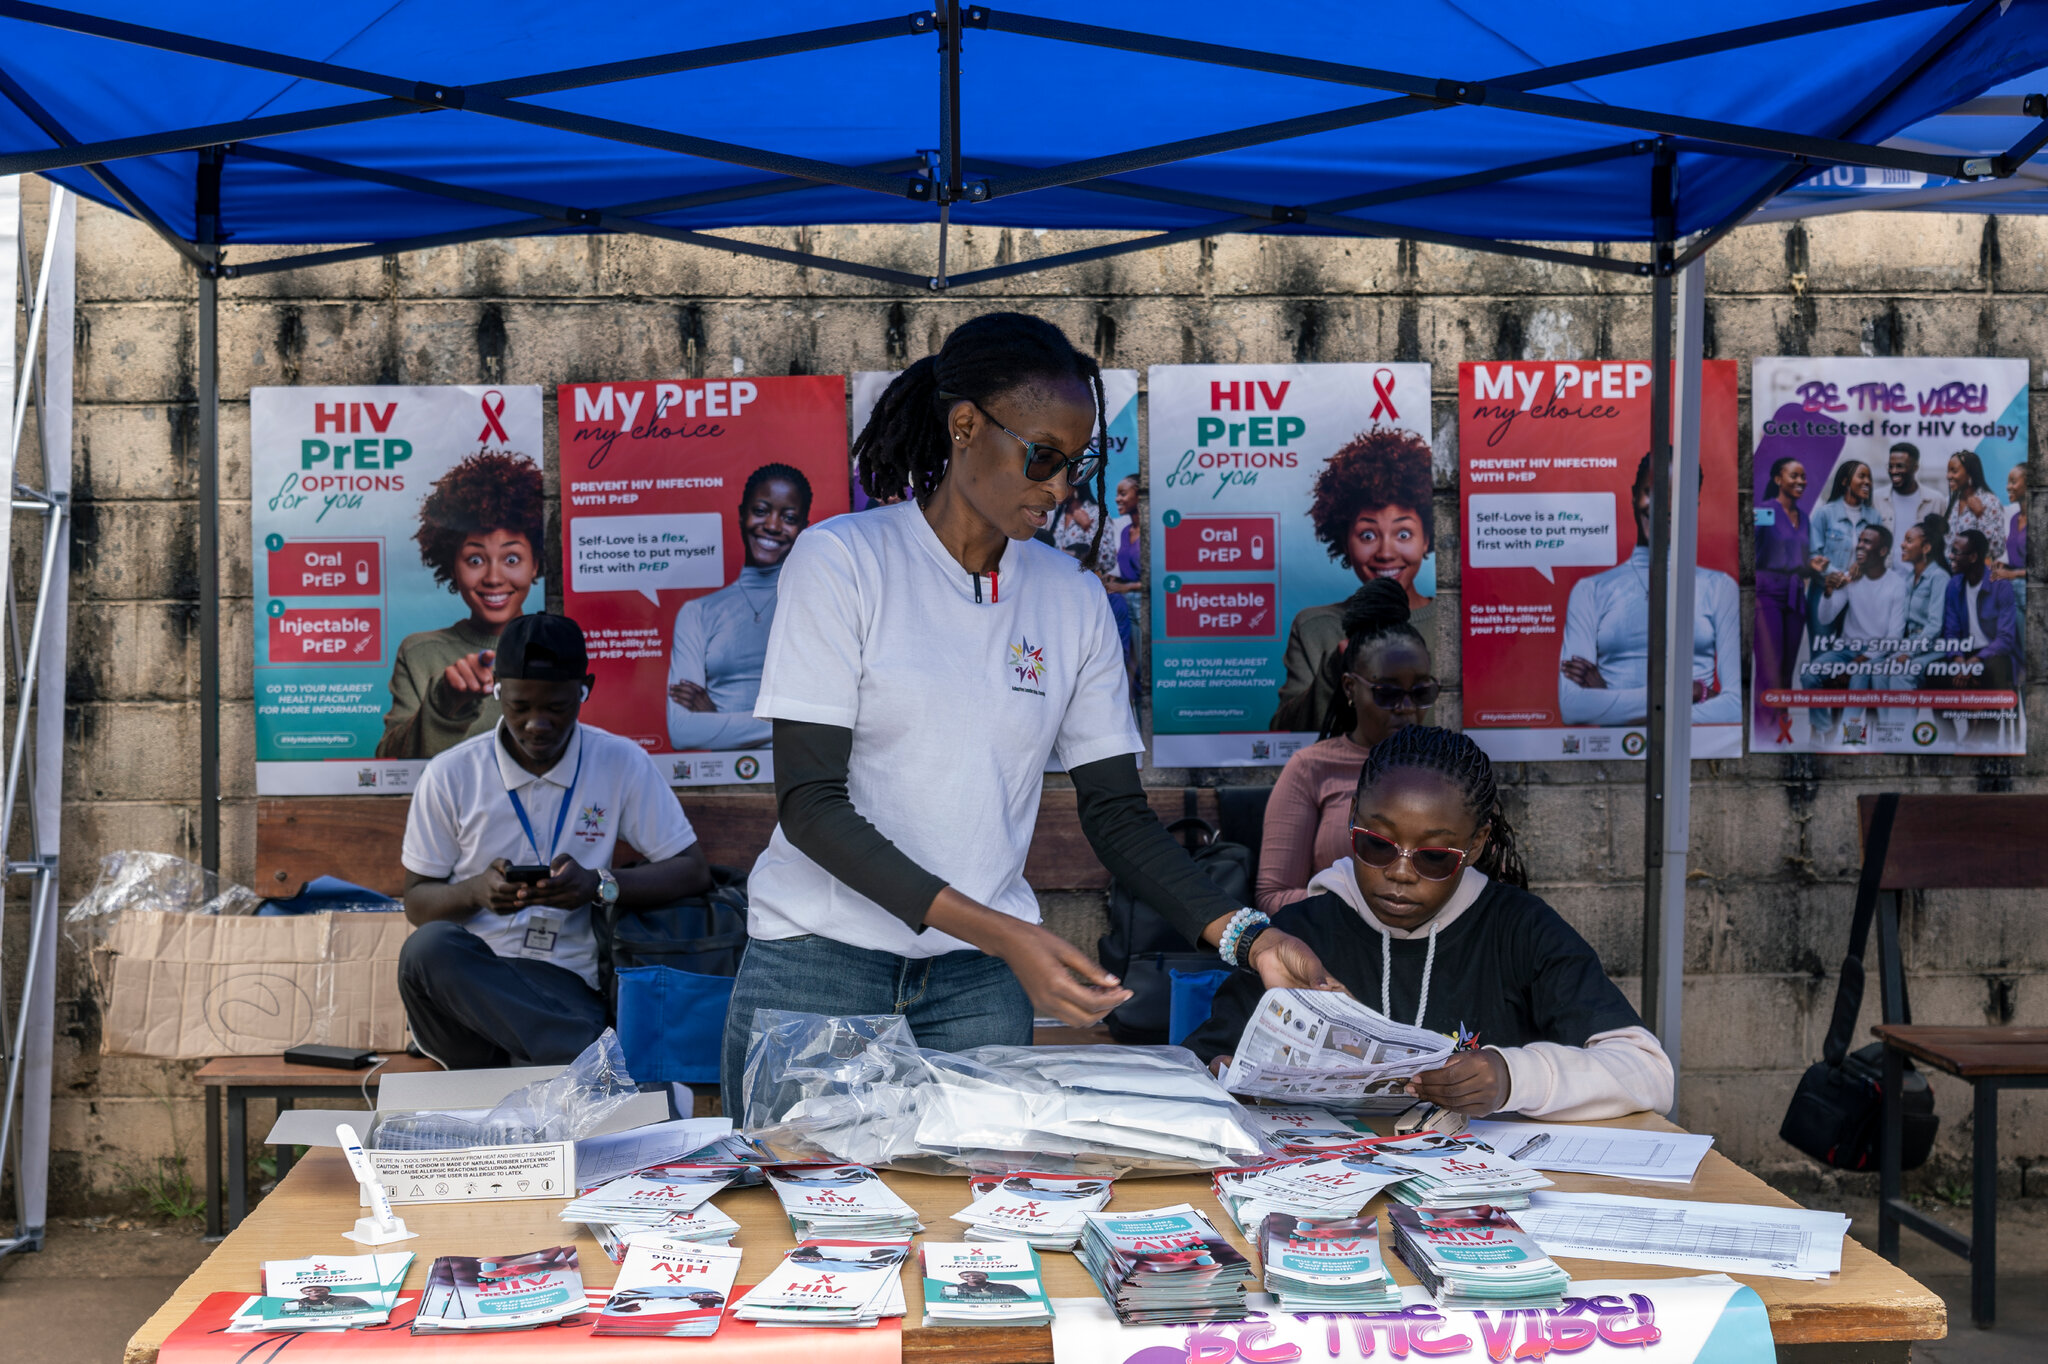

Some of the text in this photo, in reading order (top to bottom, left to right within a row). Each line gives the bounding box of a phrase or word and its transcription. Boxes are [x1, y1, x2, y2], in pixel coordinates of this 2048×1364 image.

[1474, 364, 1653, 411] My PrEP
[1210, 381, 1291, 412] HIV
[1796, 381, 1988, 417] BE THE VIBE!
[573, 381, 758, 433] My PrEP
[1473, 374, 1620, 447] my choice
[315, 402, 398, 433] HIV
[573, 393, 726, 470] my choice
[1197, 416, 1306, 447] PrEP
[1762, 419, 2020, 442] Get tested for HIV today
[301, 439, 413, 470] PrEP
[1198, 452, 1298, 469] OPTIONS
[1470, 458, 1617, 469] PREVENT HIV INFECTION
[1166, 449, 1258, 500] for you
[1470, 472, 1536, 483] WITH PrEP
[302, 475, 405, 492] OPTIONS
[571, 477, 723, 493] PREVENT HIV INFECTION
[269, 472, 363, 523] for you
[571, 493, 639, 506] WITH PrEP
[1477, 511, 1584, 523] Self-Love is a flex,
[1201, 528, 1238, 542] Oral
[1484, 526, 1527, 535] choose
[1530, 526, 1543, 535] to
[1546, 526, 1567, 538] put
[1569, 524, 1609, 538] myself
[579, 532, 688, 547] Self-Love is a flex,
[1477, 539, 1565, 550] first with PrEP
[304, 552, 342, 567] Oral
[586, 549, 630, 560] choose
[633, 549, 646, 558] to
[650, 548, 671, 562] put
[674, 545, 715, 560] myself
[1198, 548, 1242, 563] PrEP
[579, 561, 669, 574] first with PrEP
[302, 573, 346, 587] PrEP
[1169, 580, 1176, 588] 2
[273, 604, 279, 613] 2
[1176, 592, 1265, 611] Injectable
[1470, 604, 1552, 613] Go to the nearest
[1199, 613, 1242, 628] PrEP
[1470, 614, 1555, 625] Health Facility for
[280, 618, 370, 636] Injectable
[1470, 624, 1555, 636] your PrEP options
[302, 639, 347, 654] PrEP
[1813, 635, 1974, 652] It's a smart and
[1164, 657, 1268, 667] GO TO YOUR NEAREST
[1800, 658, 1984, 679] responsible move
[1176, 668, 1256, 677] HEALTH FACILITY
[1156, 678, 1275, 688] FOR MORE INFORMATION
[1442, 1163, 1488, 1172] HIV
[1305, 1173, 1355, 1186] HIV
[634, 1189, 687, 1198] HIV
[989, 1212, 1043, 1222] TESTING
[994, 1206, 1050, 1218] HIV
[1116, 1230, 1200, 1241] PREVENTION
[1425, 1231, 1494, 1241] HIV
[1133, 1236, 1204, 1250] HIV
[1289, 1239, 1360, 1252] HIV
[652, 1254, 712, 1264] TESTING
[1282, 1248, 1369, 1256] PREVENTION
[650, 1262, 709, 1274] HIV
[478, 1274, 551, 1292] HIV
[786, 1282, 849, 1294] HIV
[1298, 1305, 1473, 1361] THE
[1474, 1292, 1663, 1363] VIBE!
